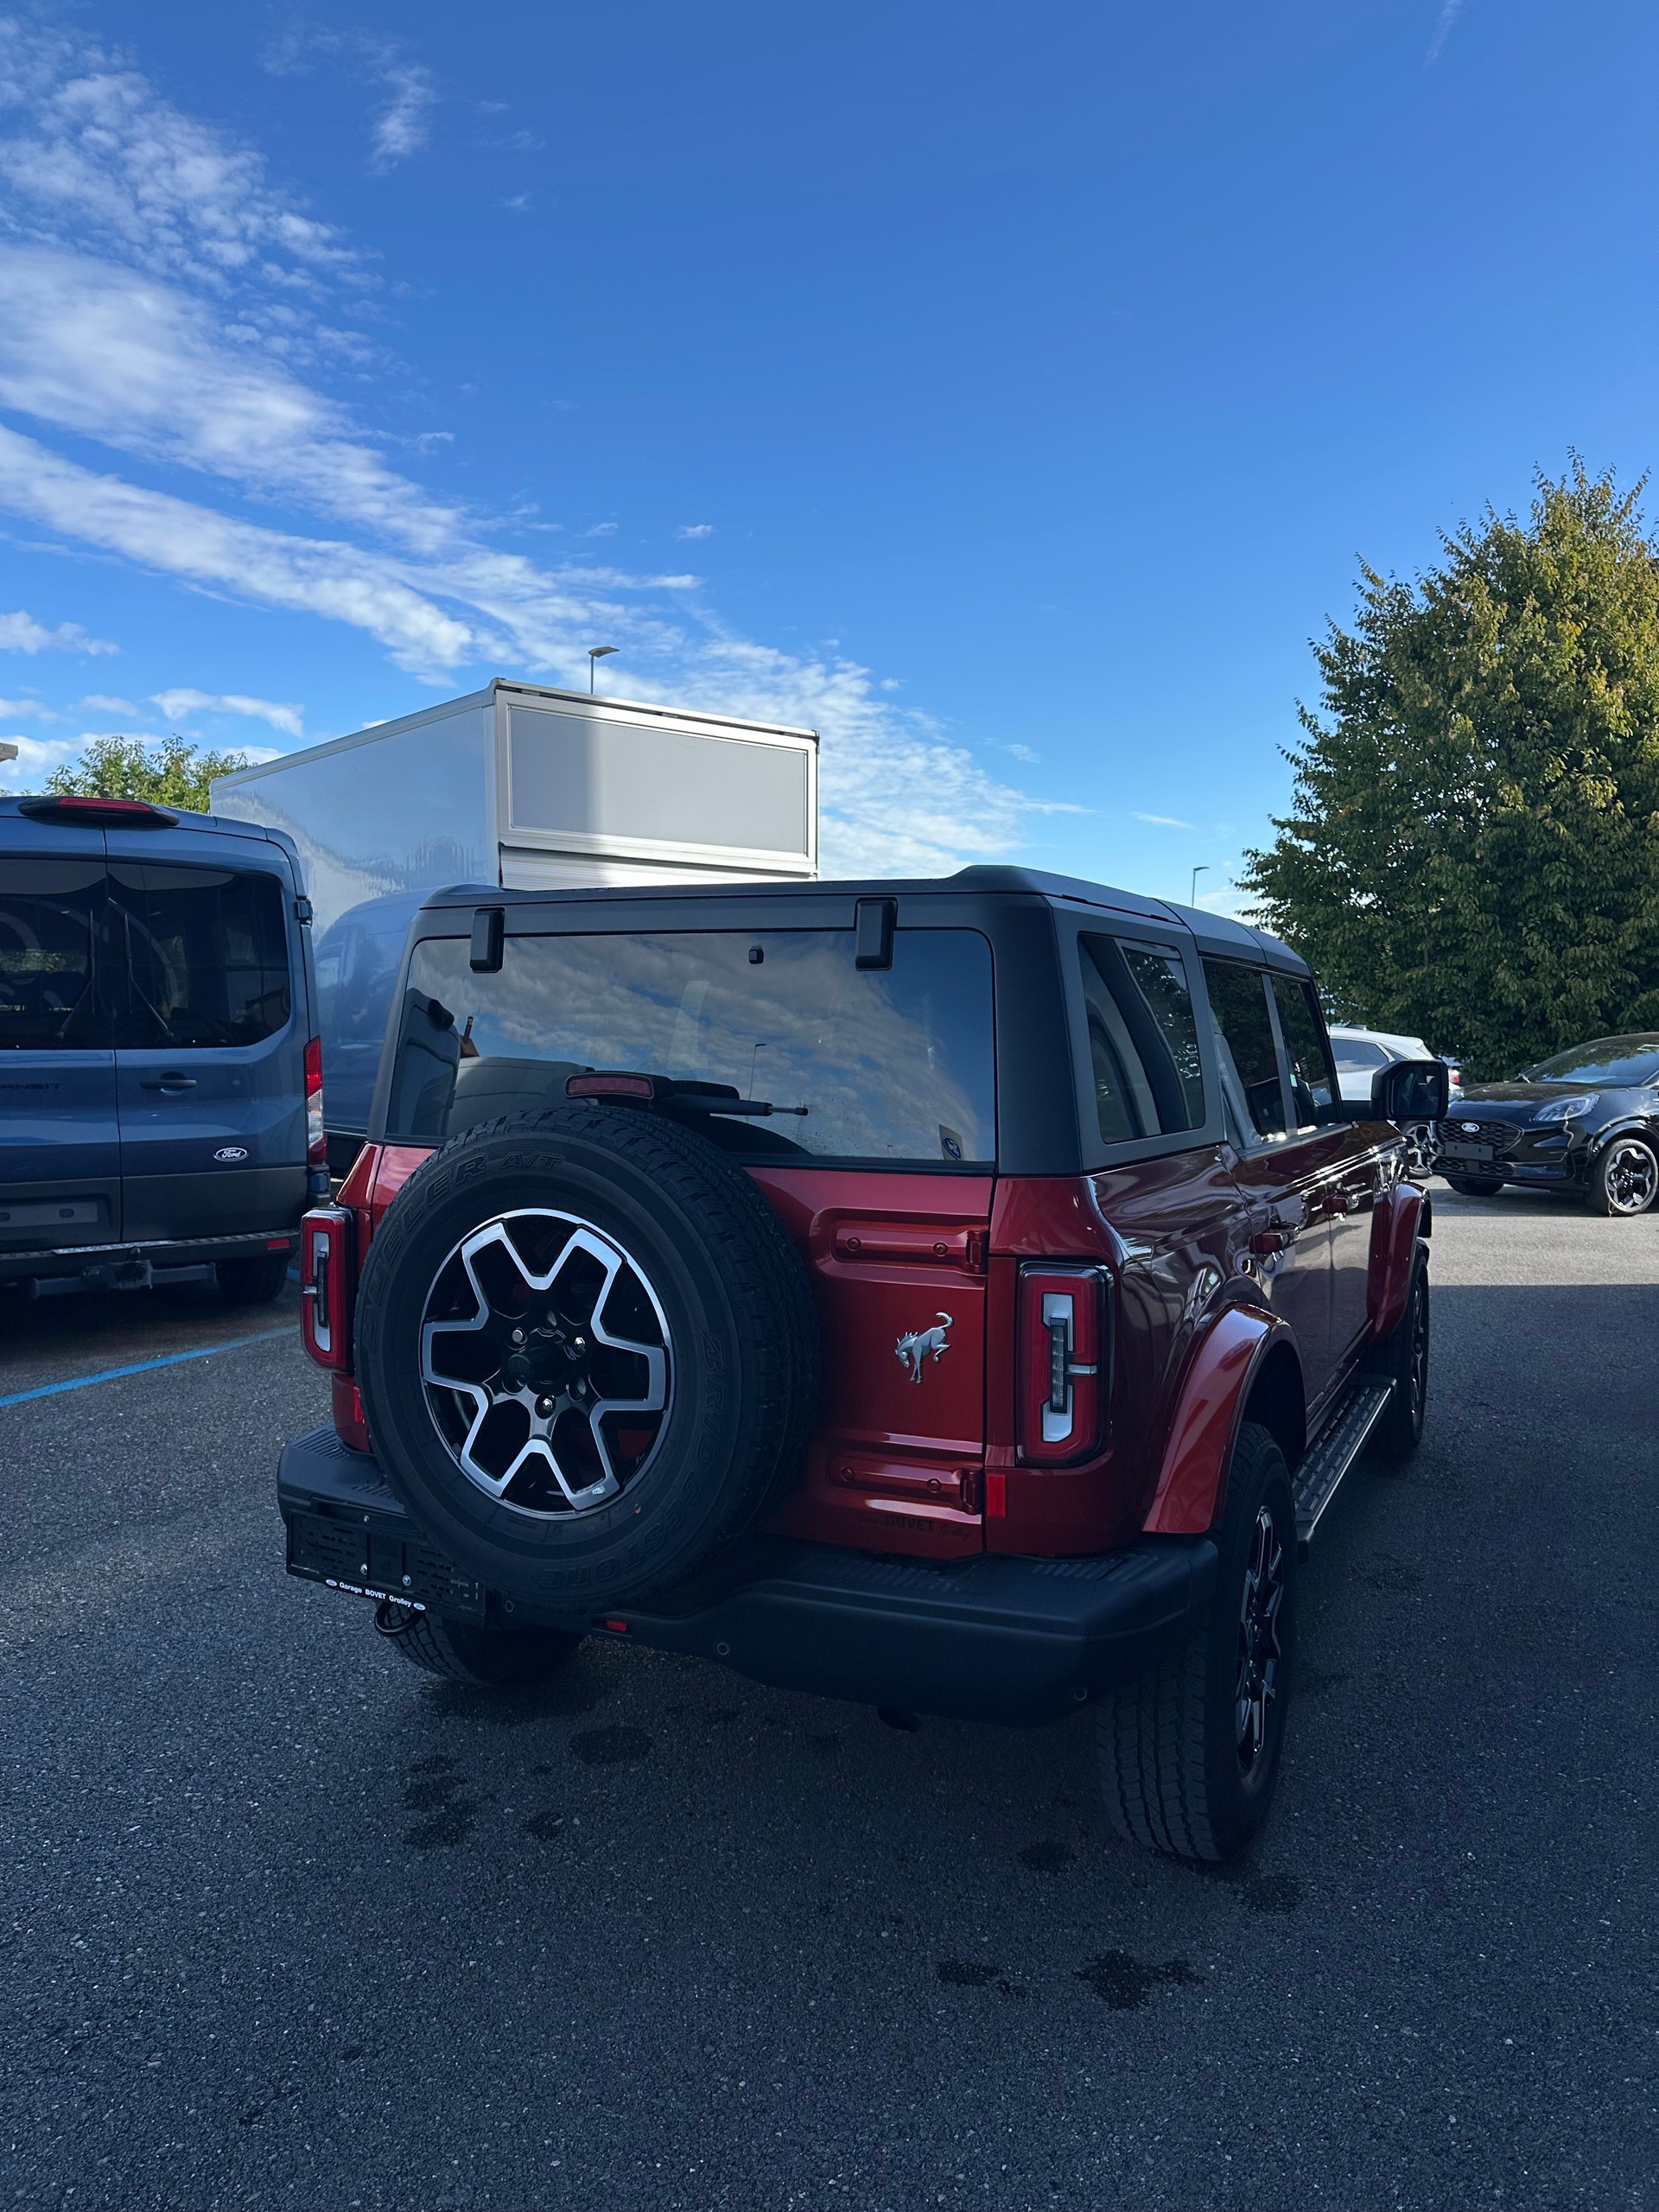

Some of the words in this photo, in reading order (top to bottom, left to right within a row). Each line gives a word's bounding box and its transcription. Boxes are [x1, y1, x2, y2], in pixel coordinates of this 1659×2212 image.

[499, 1150, 565, 1171] A/T
[539, 1330, 729, 1590] BRIDGESTONE
[339, 1582, 363, 1593] Garage
[365, 1588, 386, 1599] BOVET
[389, 1595, 411, 1607] Grolley
